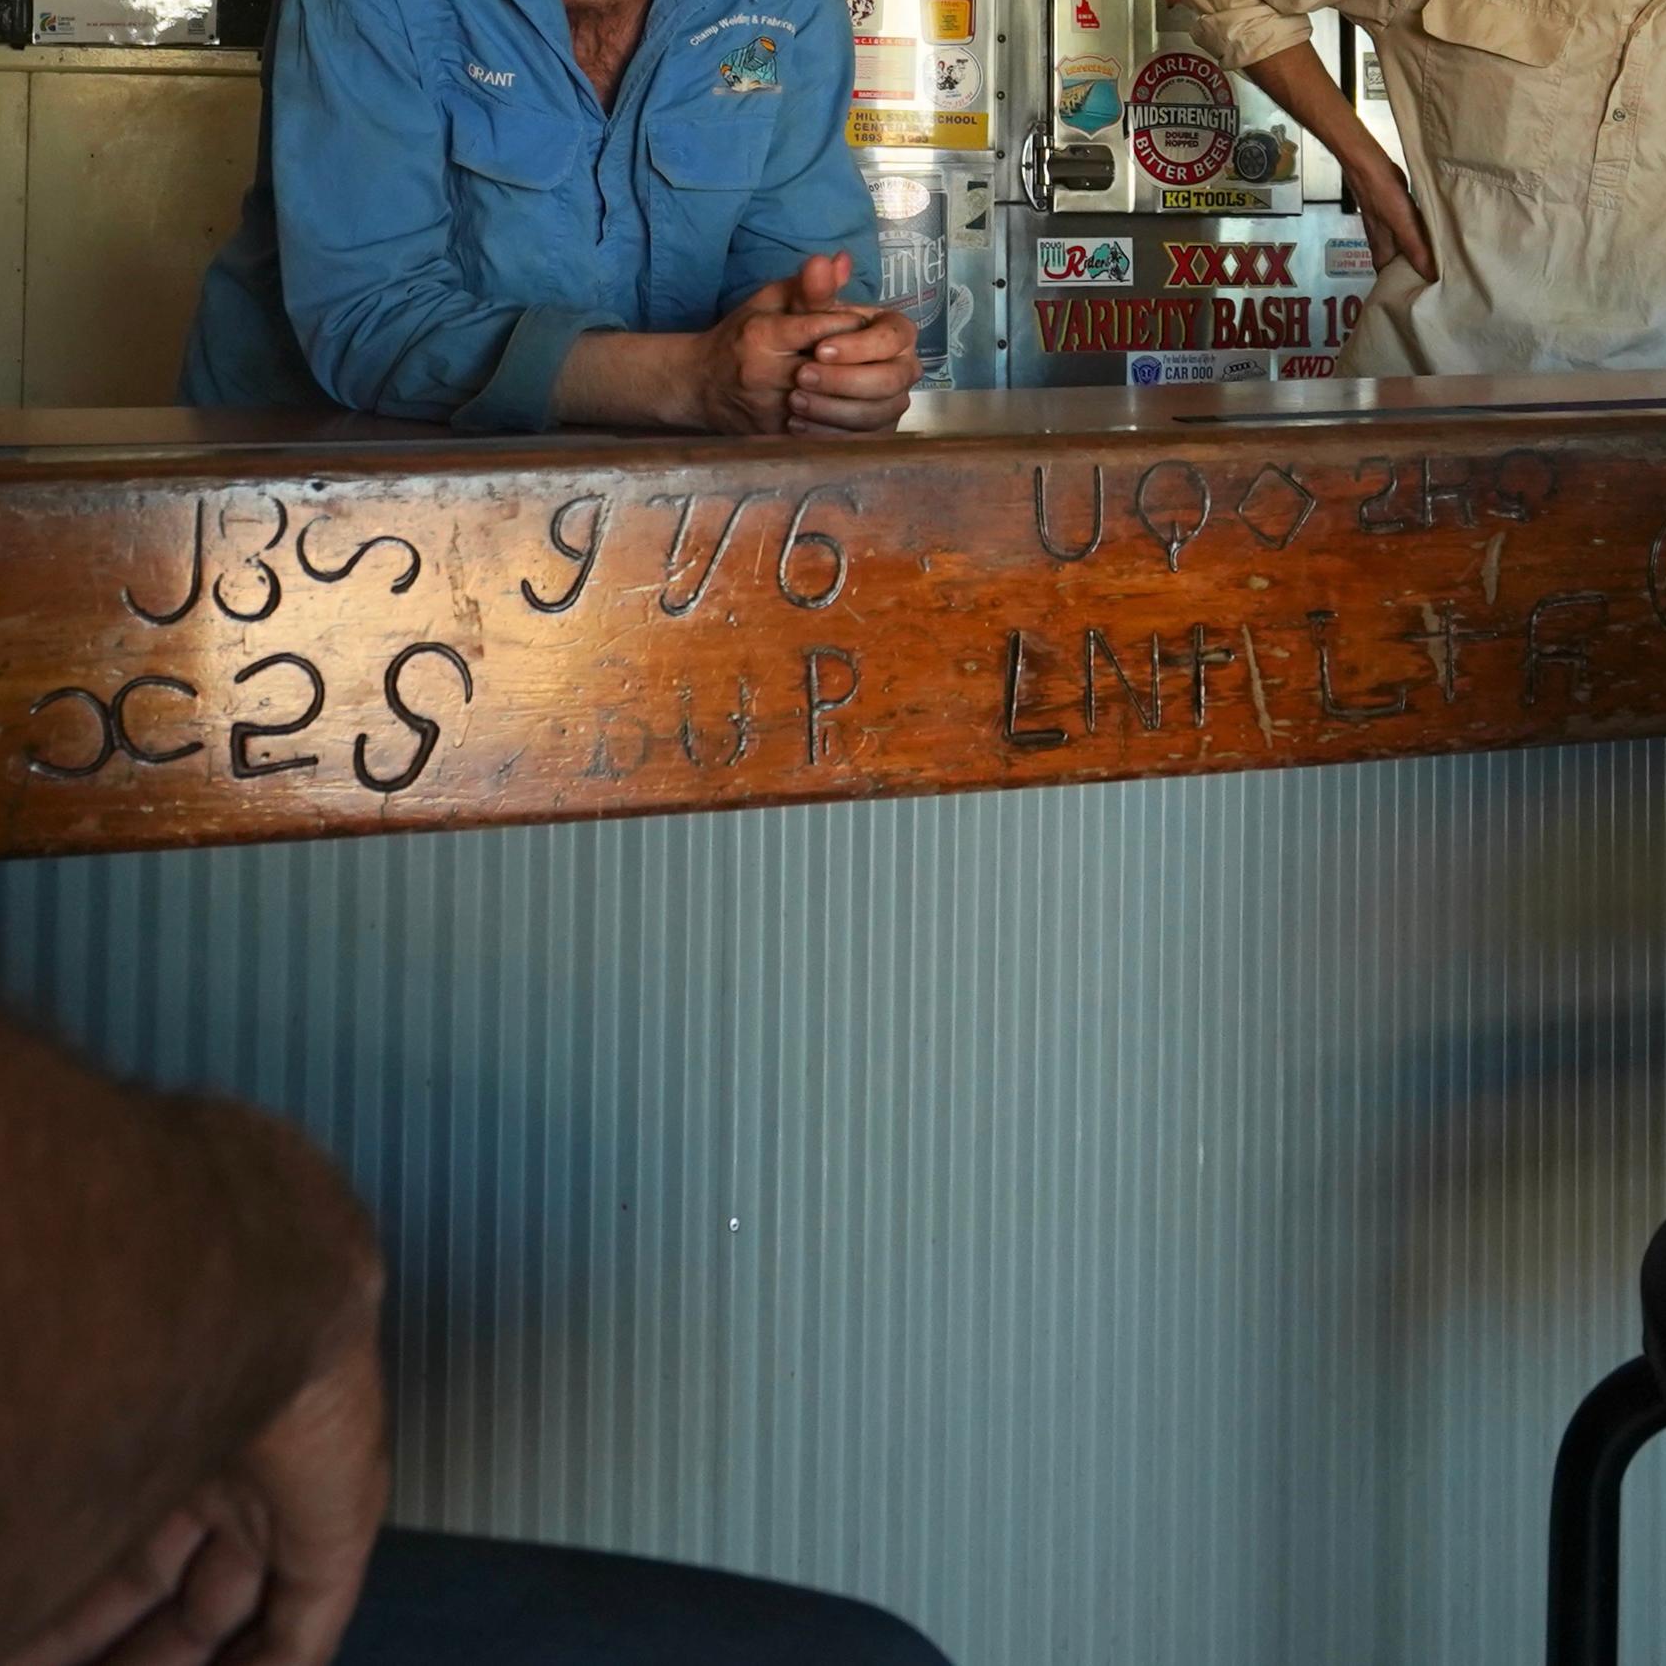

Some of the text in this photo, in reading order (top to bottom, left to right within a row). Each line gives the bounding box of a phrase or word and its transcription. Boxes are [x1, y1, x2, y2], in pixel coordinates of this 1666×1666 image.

[689, 14, 759, 48] Champ &
[467, 62, 517, 88] GRANT
[1144, 57, 1224, 90] CARLTON
[855, 111, 978, 125] HILL SCHOOL
[1127, 104, 1238, 131] MIDSTRENGTH
[853, 132, 883, 143] 1893
[1164, 130, 1201, 140] DOUBLE
[1164, 139, 1201, 149] HOPPED
[1135, 134, 1230, 181] BITTER BEER
[1164, 190, 1247, 208] KC TOOLS
[1162, 241, 1298, 289] XXXX
[1033, 295, 1312, 353] VARIETY BASH
[1164, 365, 1214, 380] CAR 000
[1280, 355, 1334, 379] 4WD
